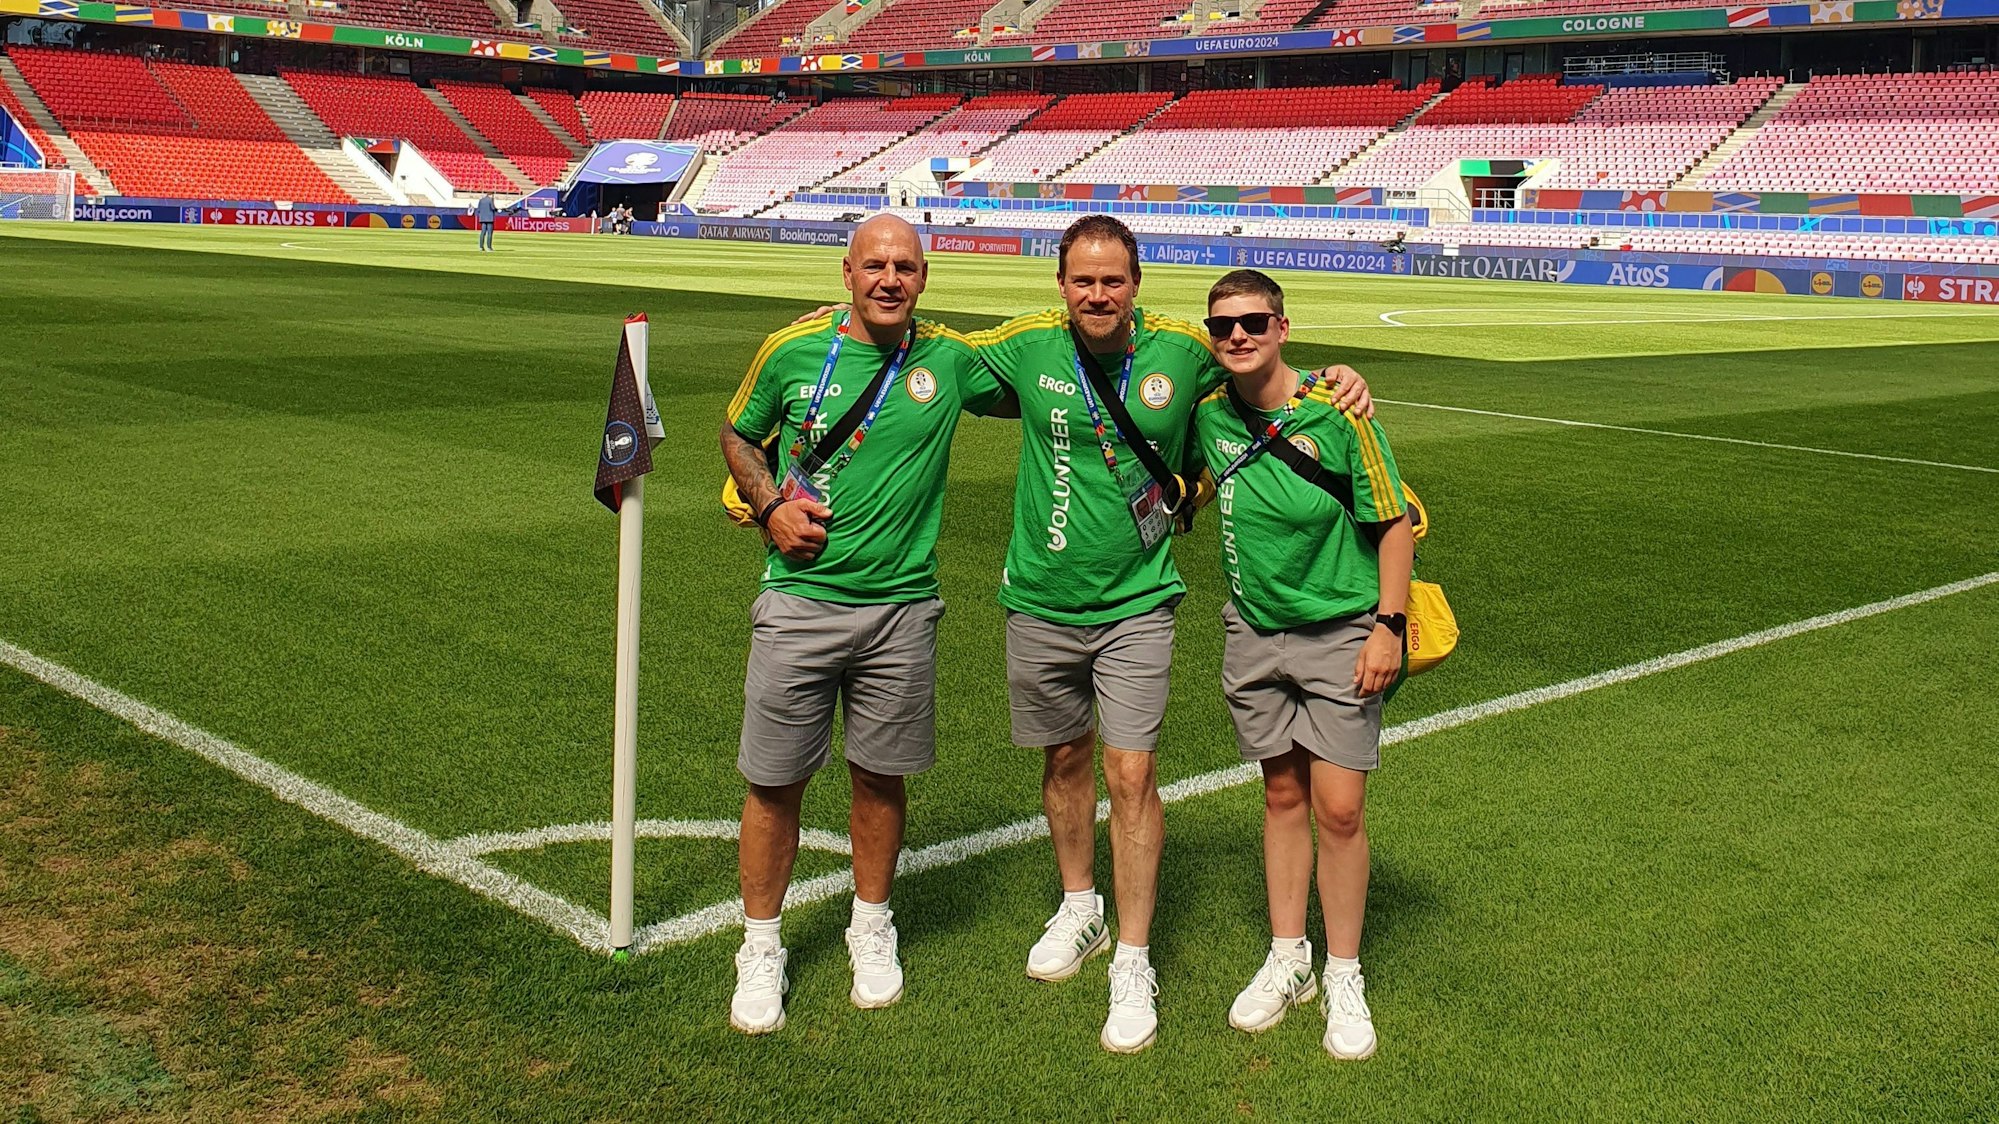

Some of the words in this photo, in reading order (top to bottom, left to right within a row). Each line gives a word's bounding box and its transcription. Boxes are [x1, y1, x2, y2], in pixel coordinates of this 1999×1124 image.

[1562, 16, 1645, 32] COLOGNE
[385, 33, 424, 48] KÖLN
[964, 51, 991, 63] KÖLN
[235, 210, 315, 226] STRAUSS
[506, 217, 570, 232] AliExpress
[650, 223, 680, 236] vivo
[700, 225, 729, 238] QATAR
[732, 226, 771, 240] AIRWAYS
[780, 228, 838, 244] Booking.com
[936, 236, 976, 252] Betano
[979, 242, 1017, 253] SPORTWETTEN
[1030, 238, 1061, 257] His
[1938, 277, 1999, 303] STR
[1038, 373, 1077, 396] ERGO
[1215, 438, 1247, 456] ERGO
[1047, 407, 1071, 551] VOLUNTEER
[1221, 477, 1243, 596] OLUNTEE
[1410, 622, 1420, 651] ERGO
